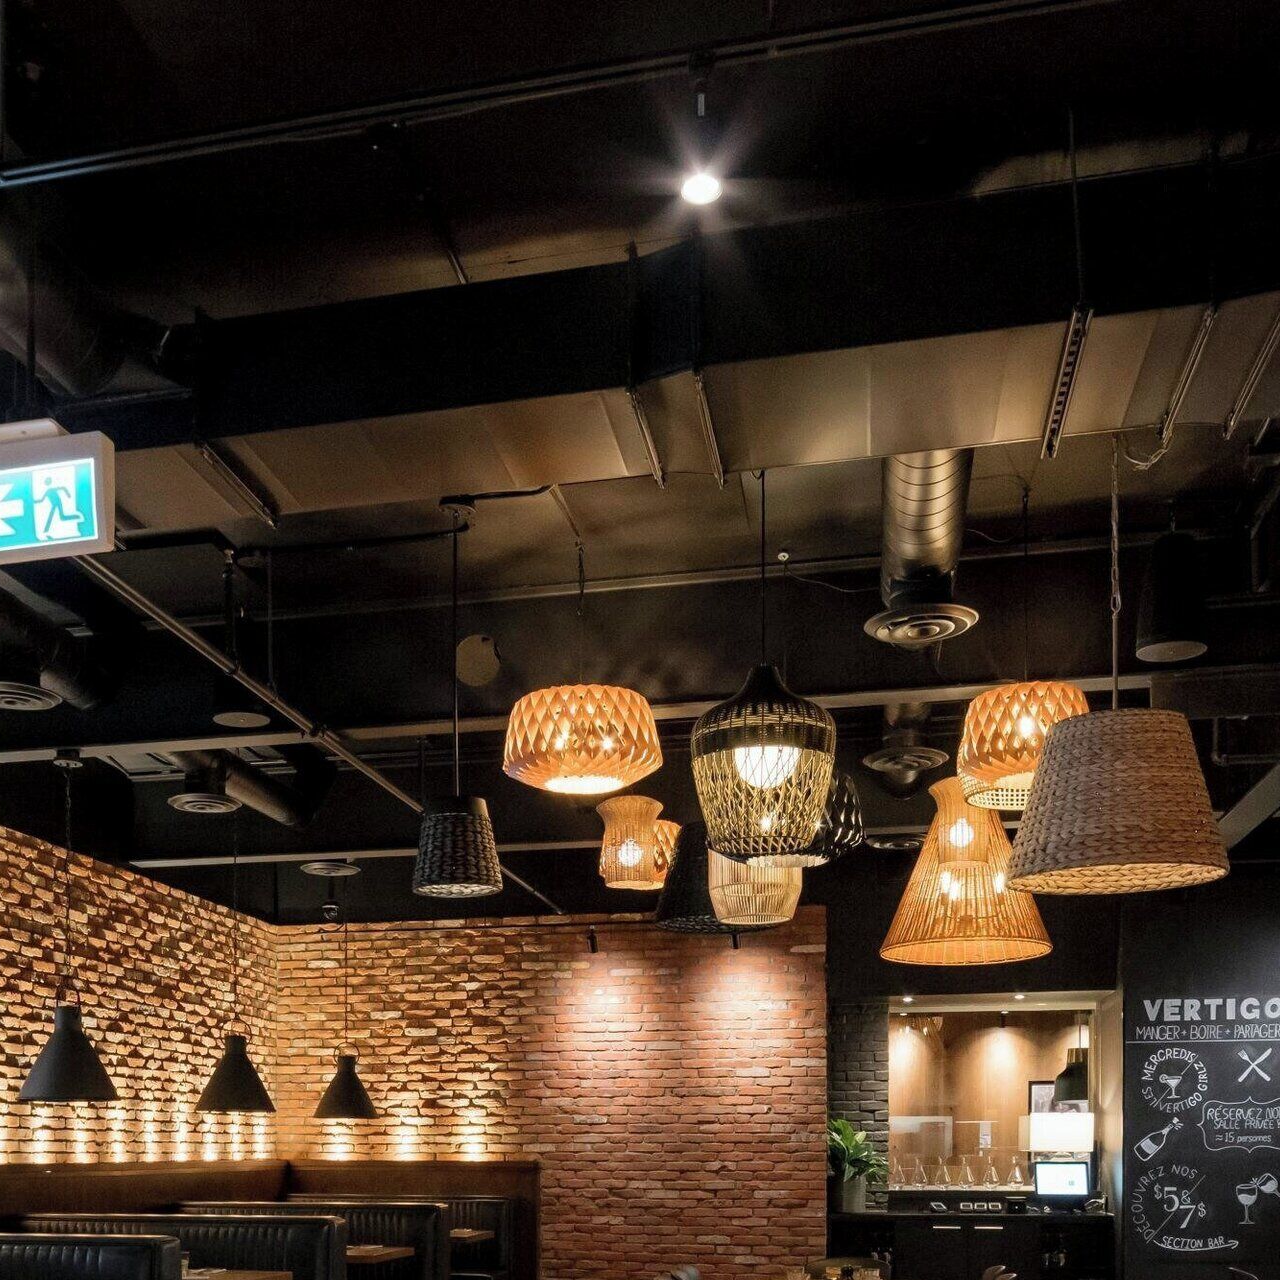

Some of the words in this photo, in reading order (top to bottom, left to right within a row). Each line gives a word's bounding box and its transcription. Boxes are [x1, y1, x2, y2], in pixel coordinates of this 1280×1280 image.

[1135, 1025, 1180, 1040] MANGER
[1190, 1024, 1223, 1040] BOIRE
[1141, 1048, 1196, 1081] MERCREDIS
[1142, 1086, 1158, 1106] LES
[1159, 1092, 1203, 1113] VERTIGO
[1193, 1061, 1208, 1092] GIRLZ
[1207, 1105, 1263, 1120] RÉSERVEZ
[1213, 1119, 1240, 1130] SALLE
[1131, 1165, 1165, 1240] DÉCOUVREZ
[1171, 1164, 1198, 1179] NOS
[1162, 1235, 1204, 1249] SECTION
[1208, 1235, 1224, 1249] BAR
